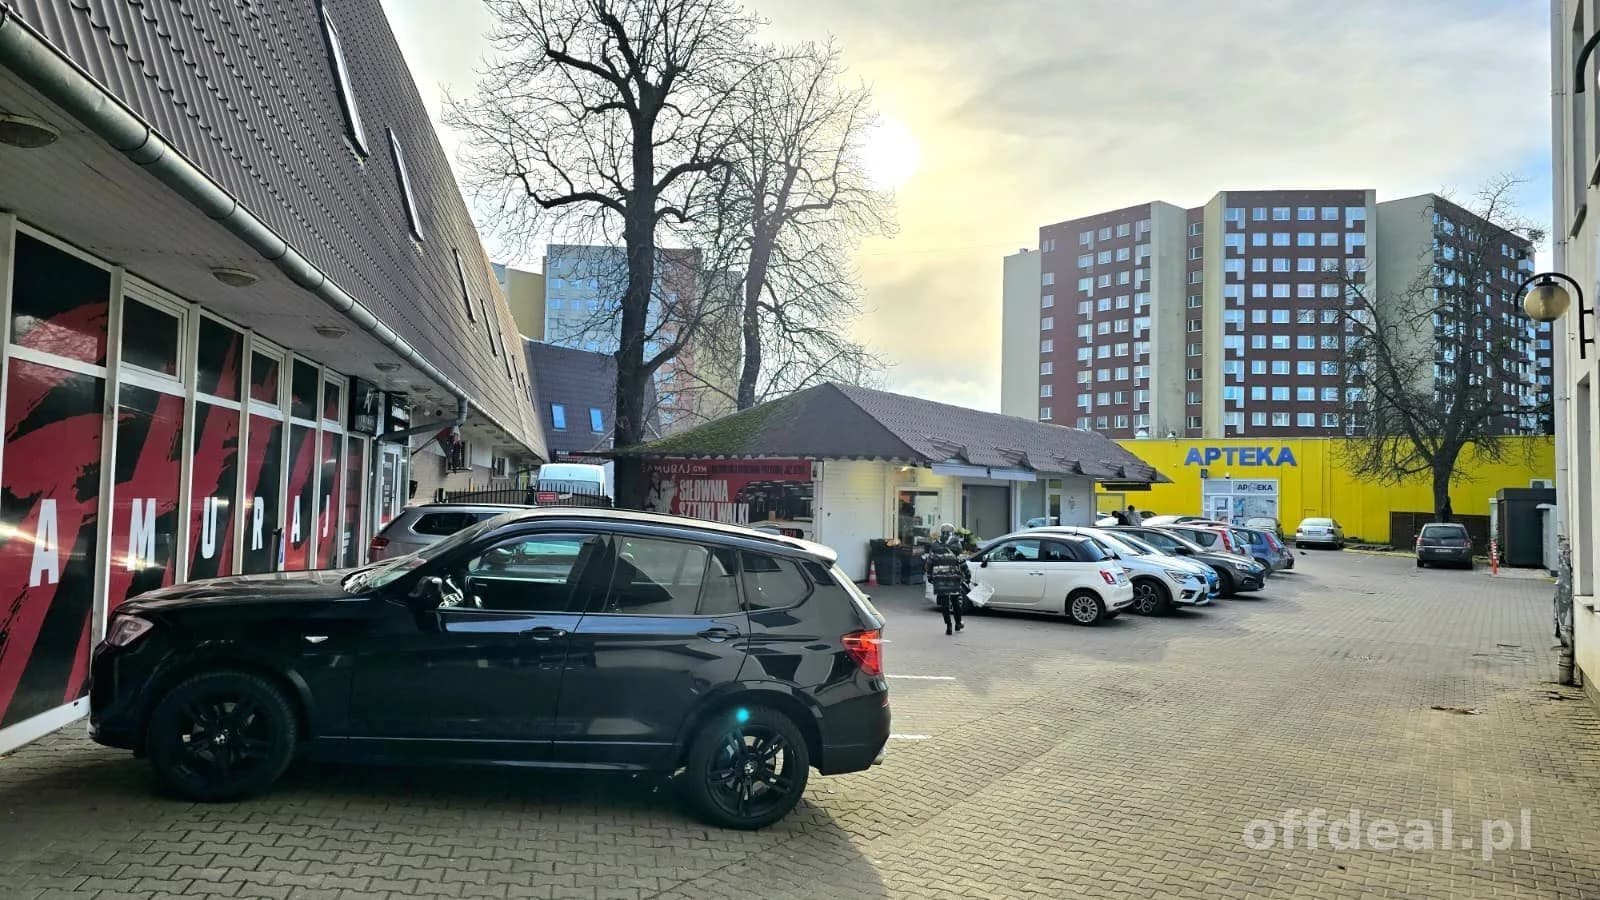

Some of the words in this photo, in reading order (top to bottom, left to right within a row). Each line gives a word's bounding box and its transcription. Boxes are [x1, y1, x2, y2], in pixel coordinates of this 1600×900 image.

[1184, 446, 1298, 467] APTEKA
[641, 463, 690, 474] SAMURAJ
[680, 479, 729, 502] SIŁOWNIA
[679, 501, 715, 520] SZTUKI
[716, 502, 750, 526] WALKI
